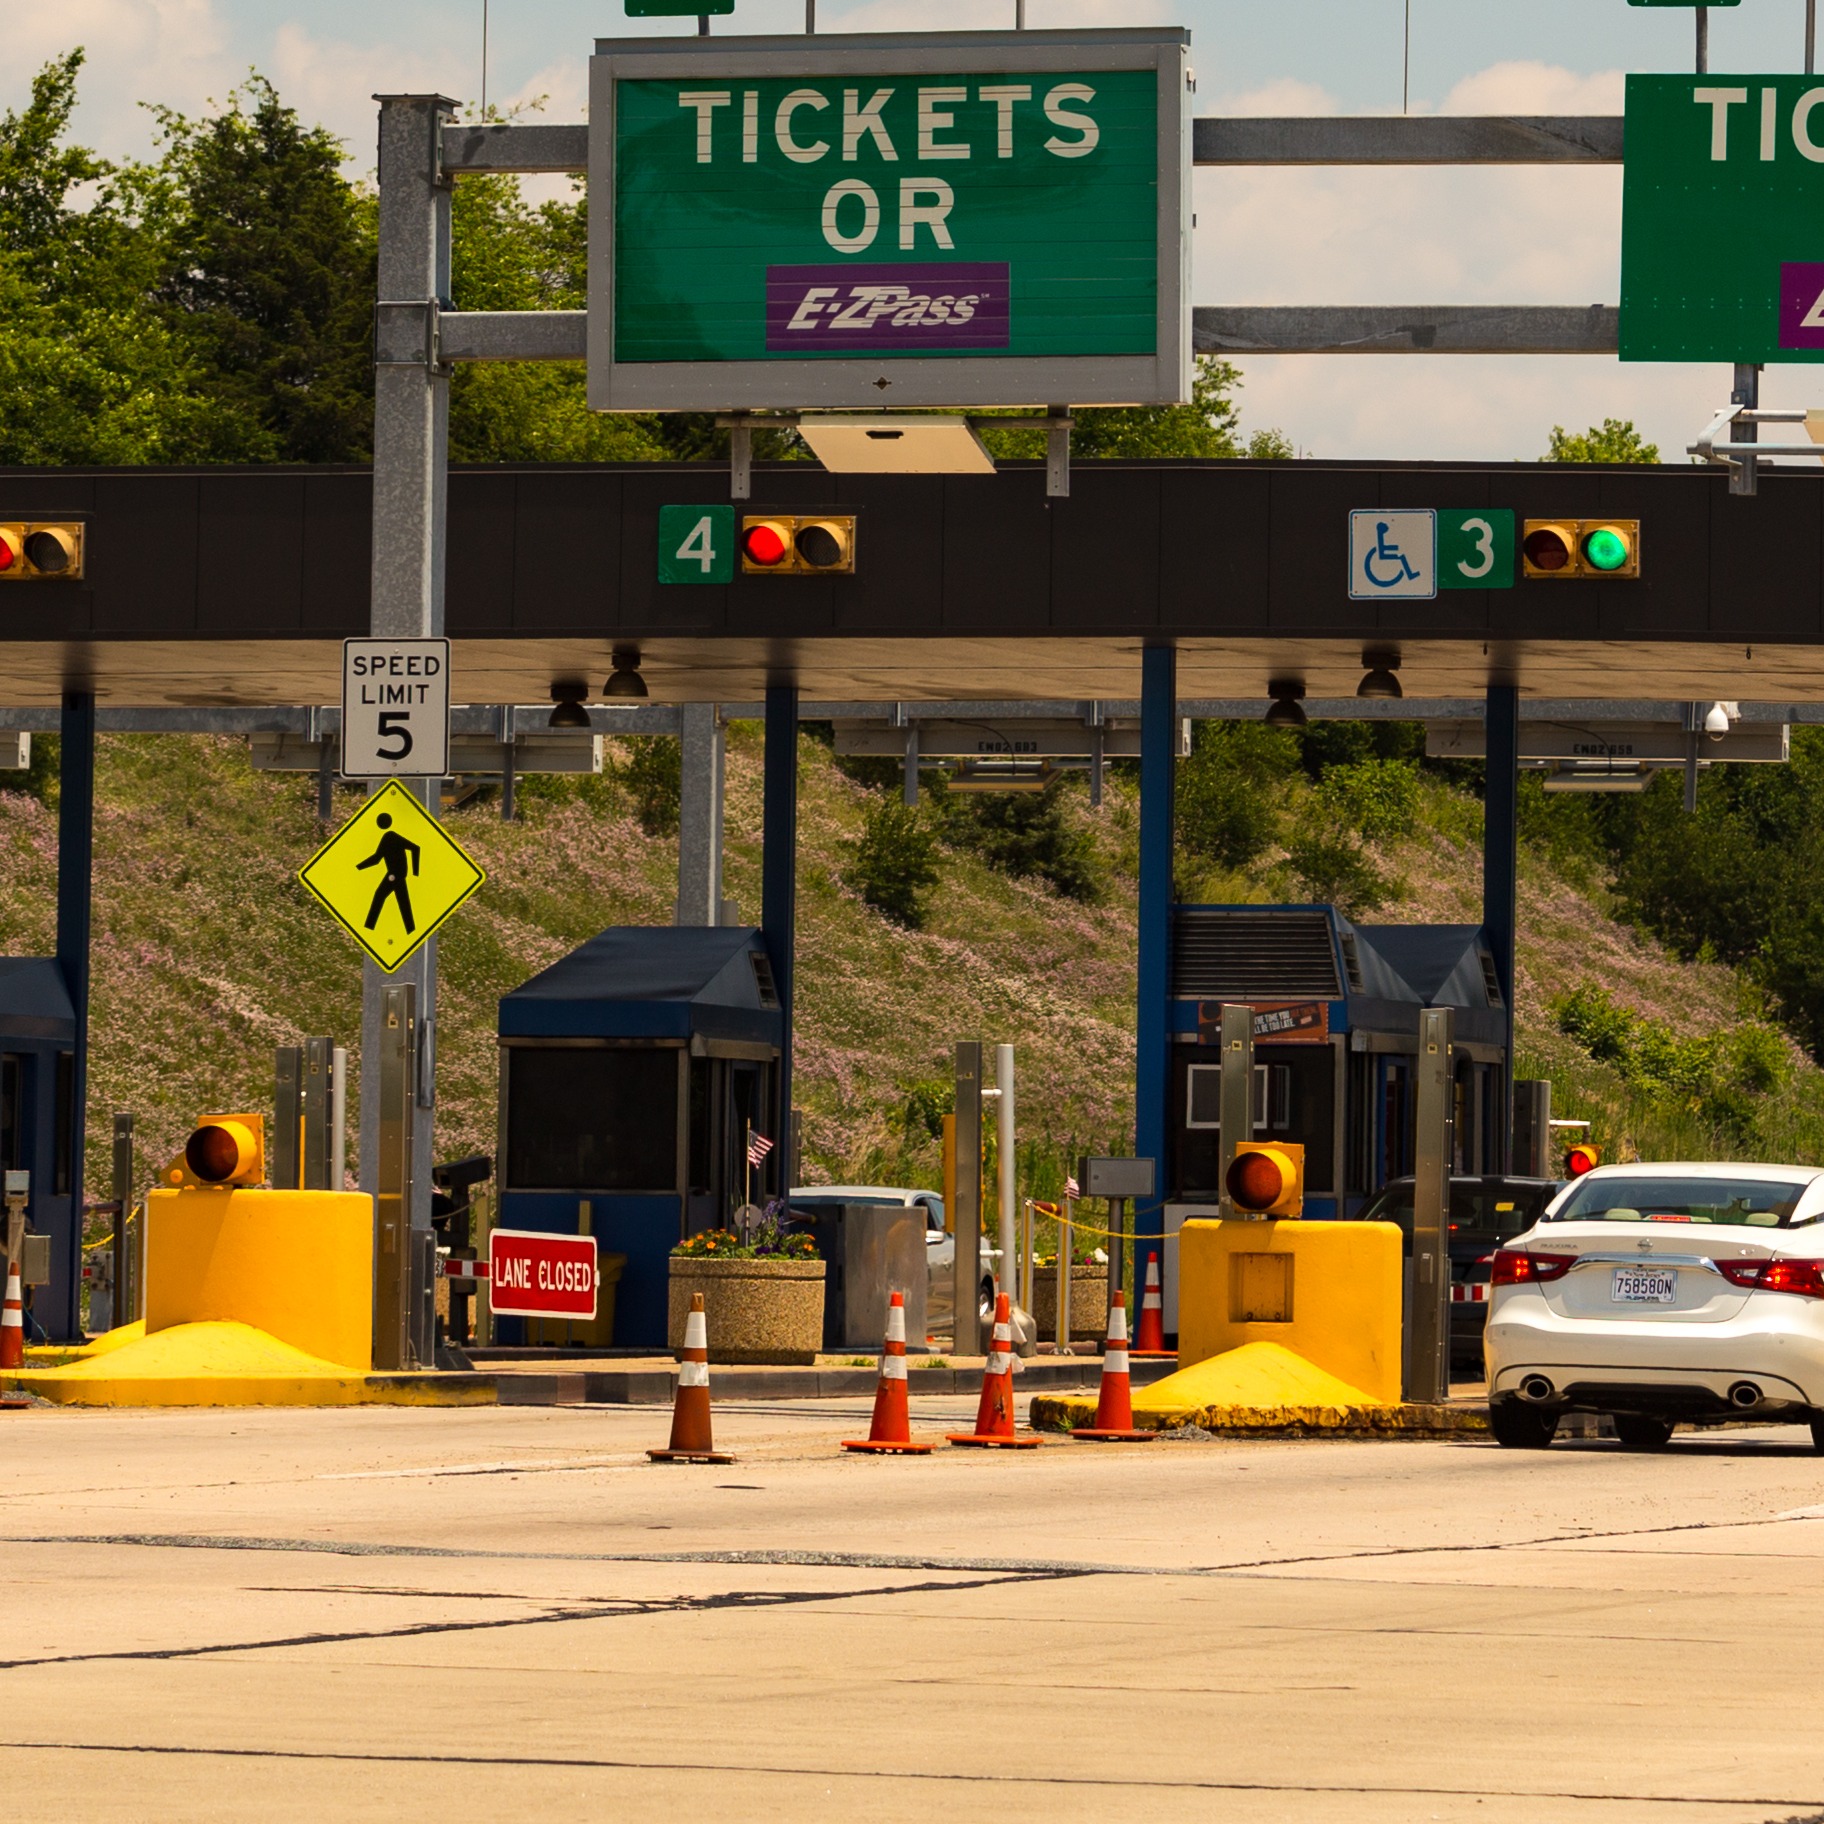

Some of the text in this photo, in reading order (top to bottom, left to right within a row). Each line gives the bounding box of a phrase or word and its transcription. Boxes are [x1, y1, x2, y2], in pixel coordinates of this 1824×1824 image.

[678, 82, 1101, 165] TICKETS
[820, 177, 956, 255] OR
[786, 285, 982, 331] E-ZPass
[675, 516, 716, 574] 4
[1456, 517, 1495, 578] 3
[352, 655, 441, 676] SPEED
[361, 684, 430, 705] LIMIT
[375, 711, 414, 761] 5
[495, 1256, 592, 1293] LANE CLOSED
